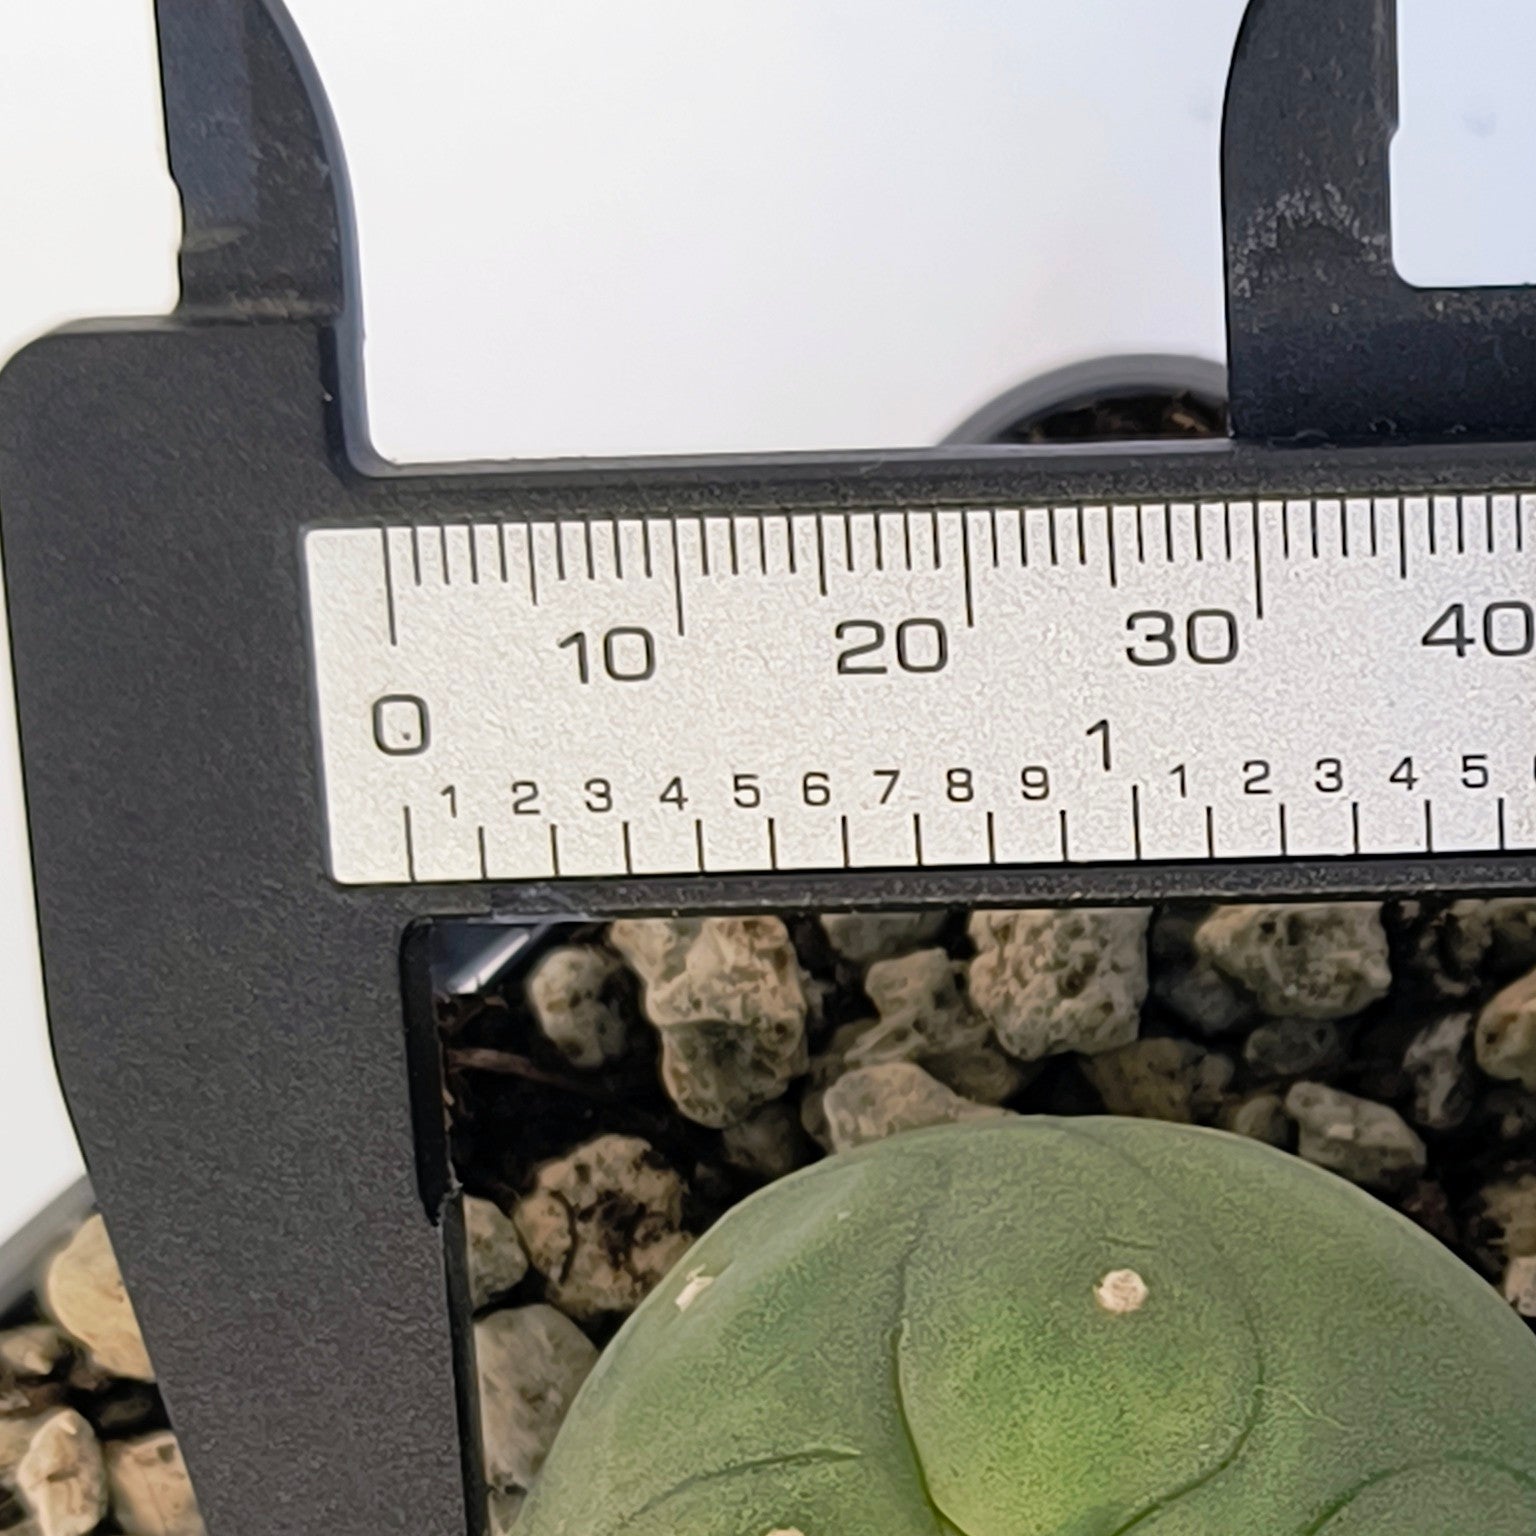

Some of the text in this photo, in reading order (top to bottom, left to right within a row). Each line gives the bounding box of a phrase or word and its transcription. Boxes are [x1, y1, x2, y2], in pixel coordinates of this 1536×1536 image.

[557, 600, 1535, 685] 10 20 30 40
[372, 694, 430, 756] 0
[1085, 719, 1112, 771] 1
[440, 785, 458, 818] 1
[511, 780, 541, 815] 2
[584, 778, 613, 814] 3
[659, 776, 689, 811] 4
[732, 774, 761, 809] 5
[802, 771, 831, 807] 6
[872, 769, 901, 805] 7
[946, 767, 974, 803] 8
[1020, 765, 1050, 801] 9
[1168, 764, 1186, 798] 1
[1242, 760, 1272, 795] 2
[1314, 758, 1343, 793] 3
[1389, 756, 1419, 791] 4
[1461, 754, 1489, 789] 5
